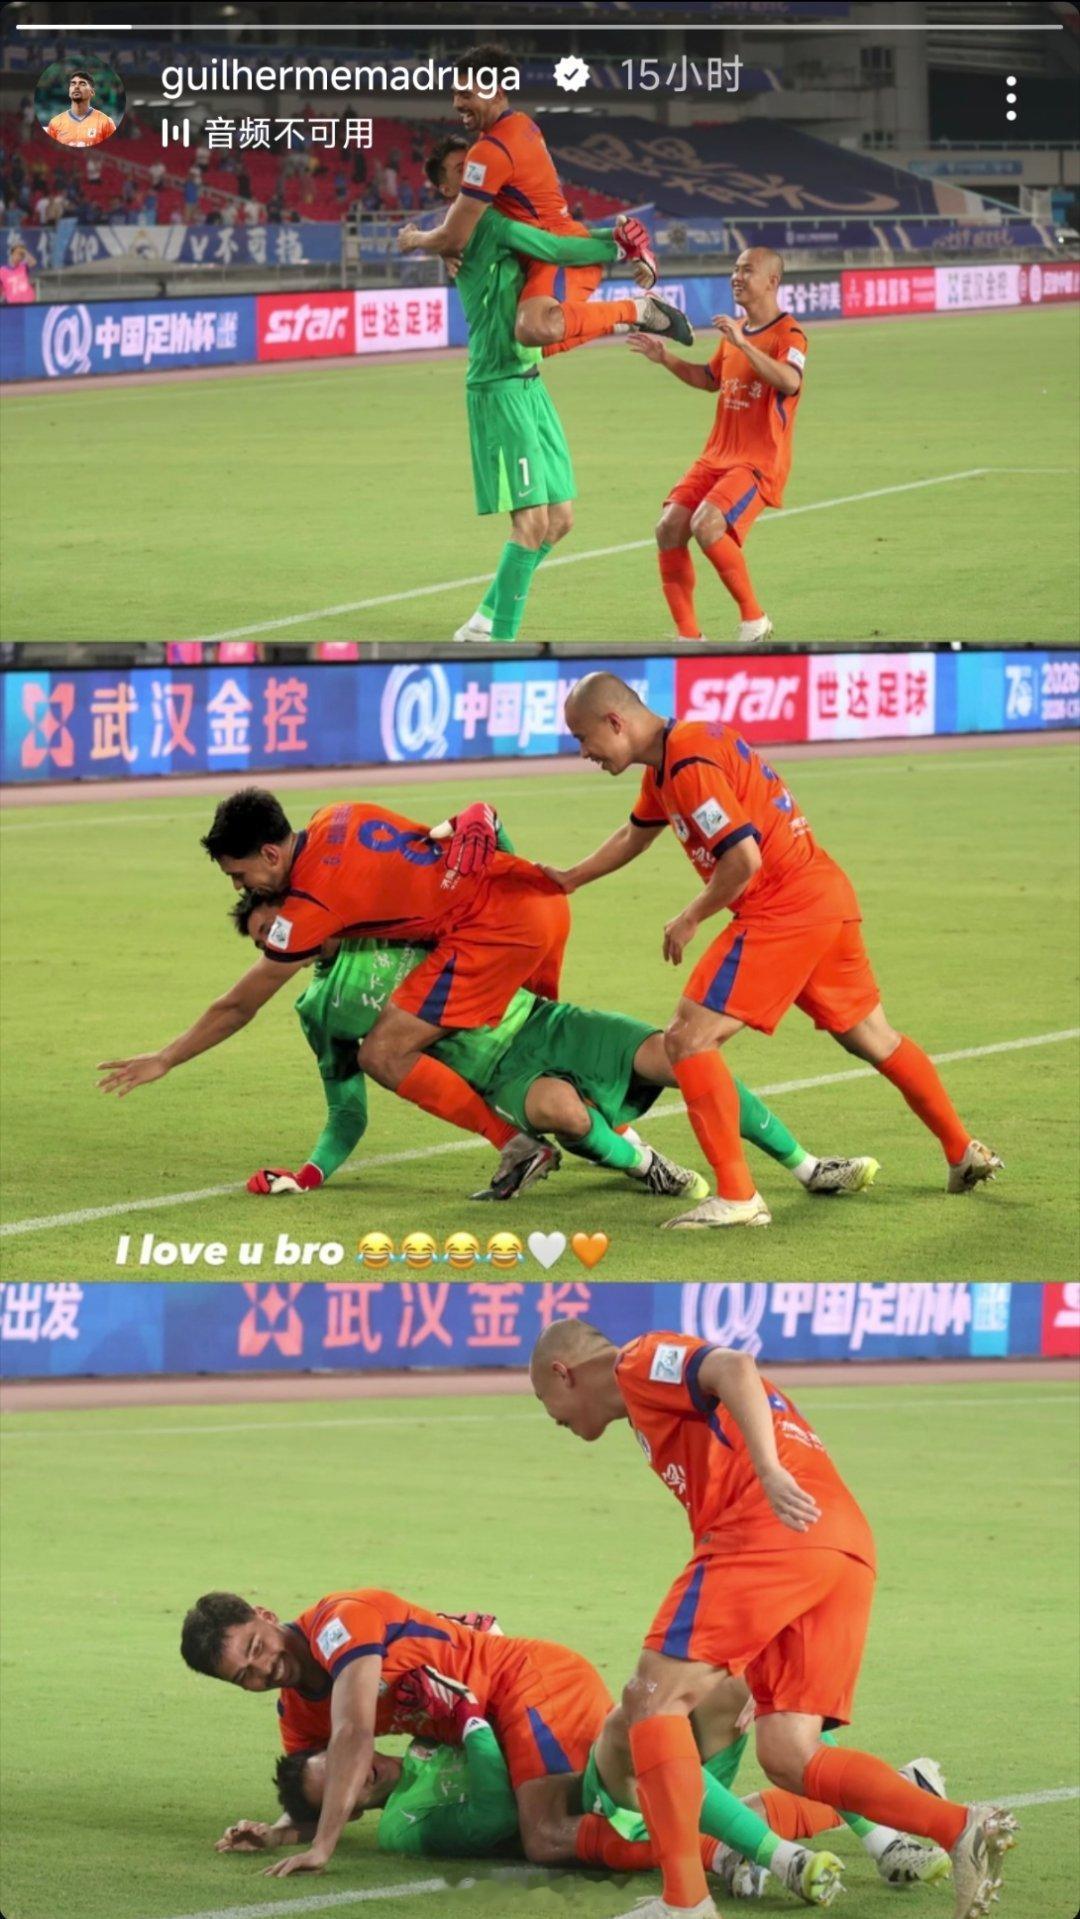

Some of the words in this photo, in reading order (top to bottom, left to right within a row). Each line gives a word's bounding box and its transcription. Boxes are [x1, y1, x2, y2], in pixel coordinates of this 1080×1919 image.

[264, 304, 350, 344] star
[361, 300, 443, 338] 世达足球
[518, 457, 530, 486] 1
[90, 677, 308, 762] 武汉金控
[453, 681, 582, 748] 中国足
[685, 671, 799, 723] star
[817, 670, 928, 721] 世达足球
[357, 819, 444, 867] 8
[0, 1283, 84, 1343] 出发
